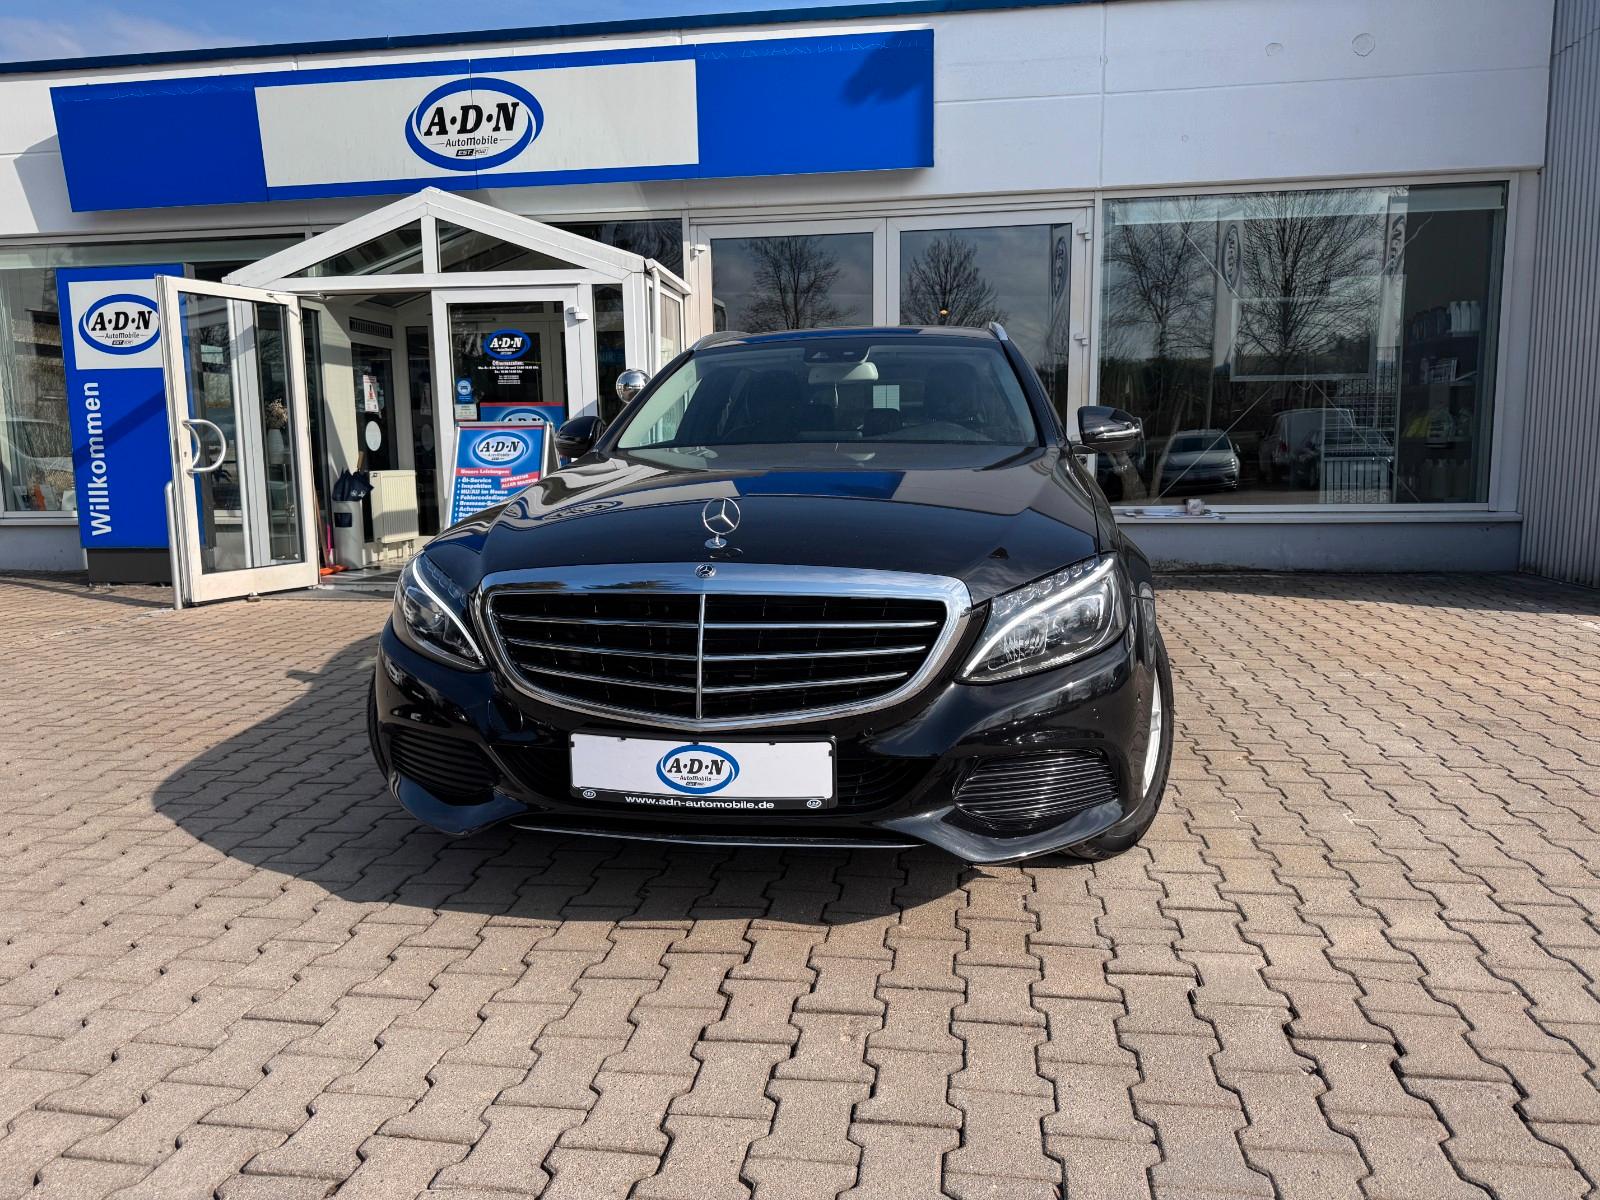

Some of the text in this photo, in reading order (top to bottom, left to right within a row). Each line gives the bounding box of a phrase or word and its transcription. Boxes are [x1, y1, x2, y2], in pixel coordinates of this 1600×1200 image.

[445, 136, 498, 148] AutoMobile
[83, 382, 112, 536] Willkommen
[625, 796, 774, 809] www.adn-automobile.de
